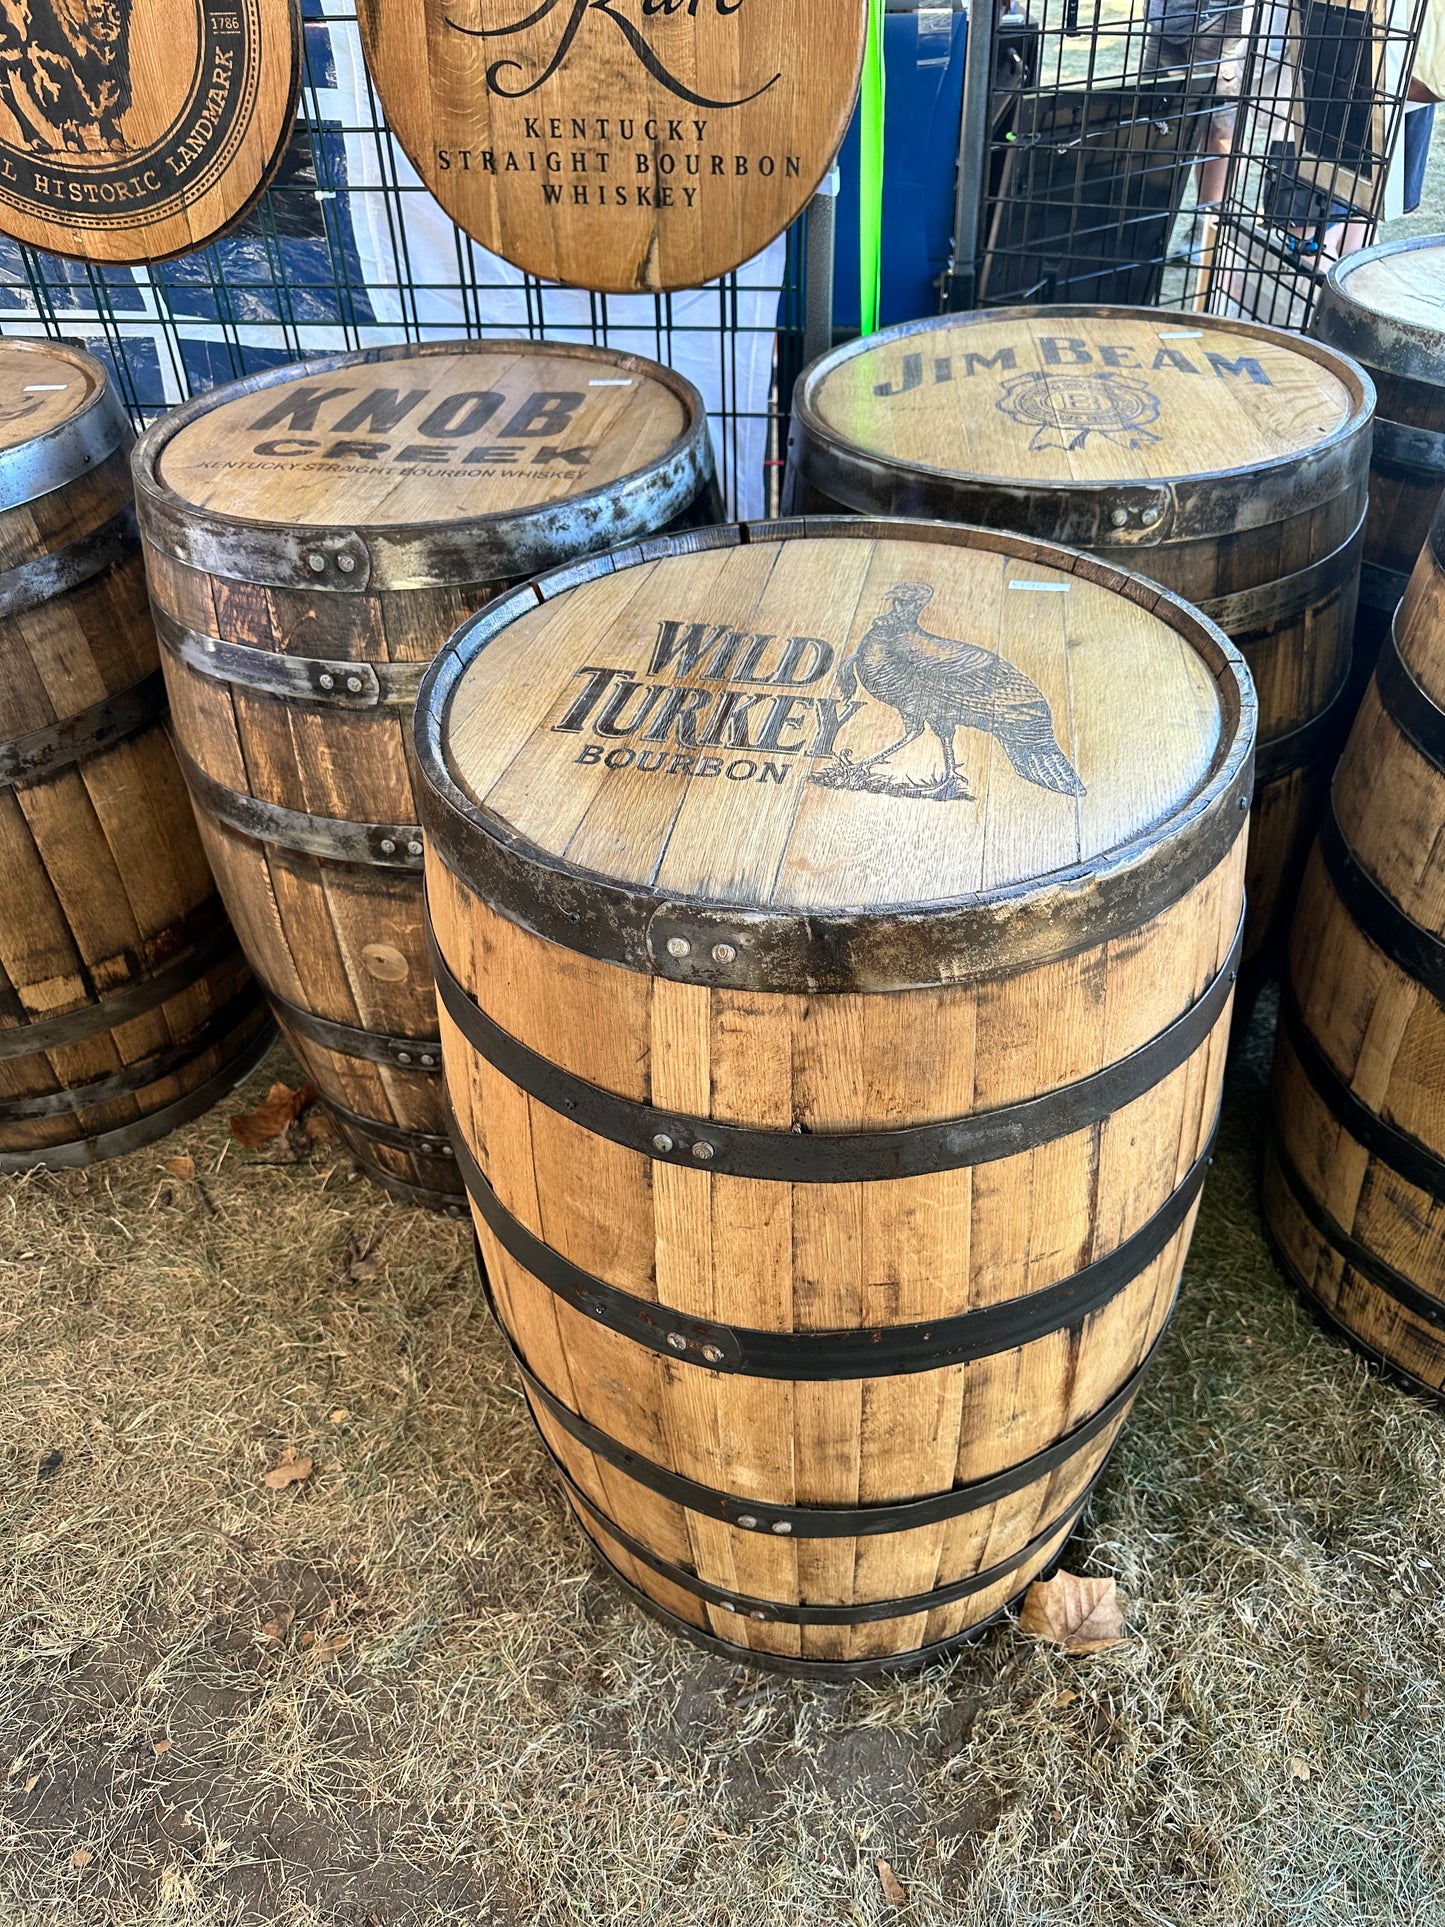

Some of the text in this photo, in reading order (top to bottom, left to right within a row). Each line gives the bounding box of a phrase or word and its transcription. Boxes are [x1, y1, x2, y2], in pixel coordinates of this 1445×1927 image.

[211, 17, 240, 30] 1786
[34, 170, 162, 203] HISTORIC
[165, 46, 234, 176] LANDMARK
[523, 117, 709, 142] KENTUCKY
[438, 150, 802, 177] STRAIGHT BOURBON
[541, 183, 698, 208] WHISKEY
[873, 336, 1276, 396] JIM BEAM
[248, 387, 588, 440] KNOB
[253, 439, 598, 466] CREEK
[198, 460, 589, 480] KENTUCKY STRAIGHT BOURBON WHISKEY
[646, 619, 834, 688] WILD
[550, 664, 869, 760] TURKEY
[574, 743, 793, 785] BOURBON
